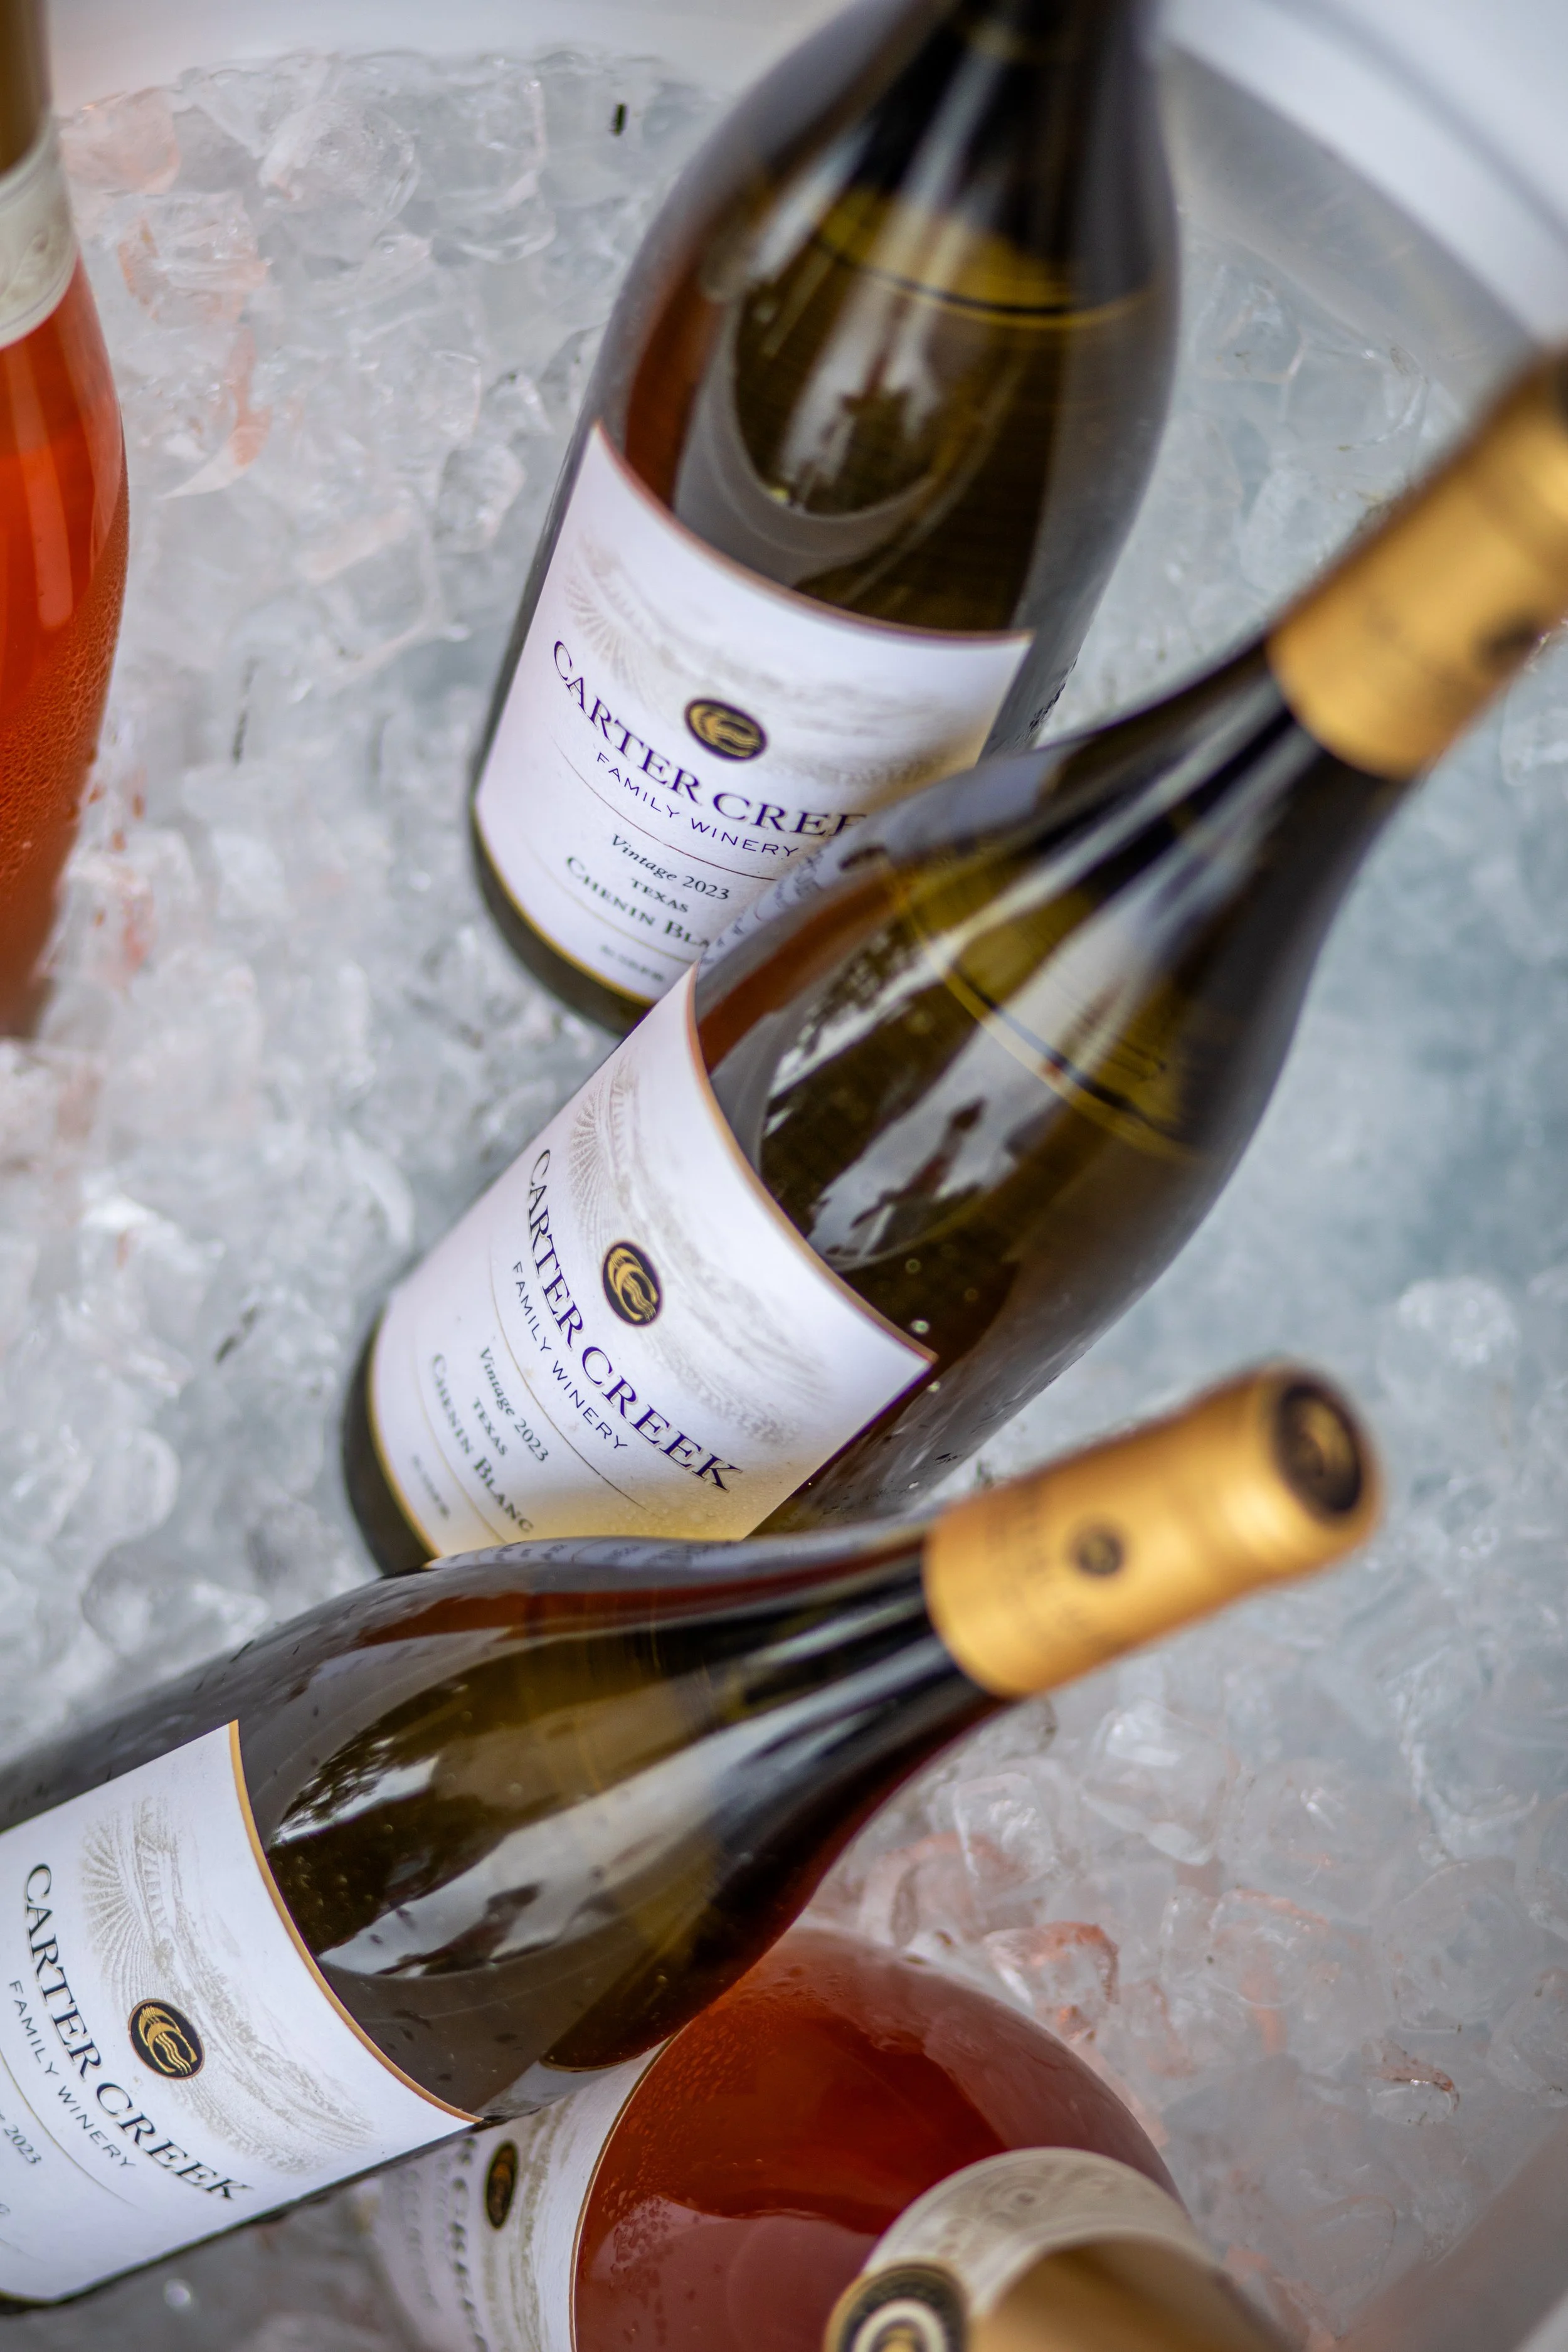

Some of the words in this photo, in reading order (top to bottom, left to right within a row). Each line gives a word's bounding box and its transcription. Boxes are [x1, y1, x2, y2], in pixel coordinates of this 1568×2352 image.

[554, 640, 702, 805] CARTER
[712, 792, 867, 837] CREE
[596, 751, 680, 818] FAMILY
[691, 817, 799, 857] WINERY
[611, 834, 677, 880] Vintage
[682, 875, 730, 900] 2023
[631, 877, 689, 913] TEXAS
[664, 919, 709, 948] BLA
[512, 1261, 552, 1352] FAMILY
[552, 1360, 628, 1451] WINERY
[528, 1148, 585, 1350] CARTER
[581, 1345, 743, 1493] CREEK
[472, 1396, 508, 1456] TEXAS
[480, 1345, 516, 1417] Vintage
[514, 1417, 549, 1463] 2023
[474, 1456, 534, 1534] BLANC
[9, 1979, 59, 2077] FAMILY
[58, 2085, 136, 2167] WINERY
[23, 1863, 103, 2080] CARTER
[95, 2082, 253, 2201] CREEK
[3, 2123, 42, 2164] 2023
